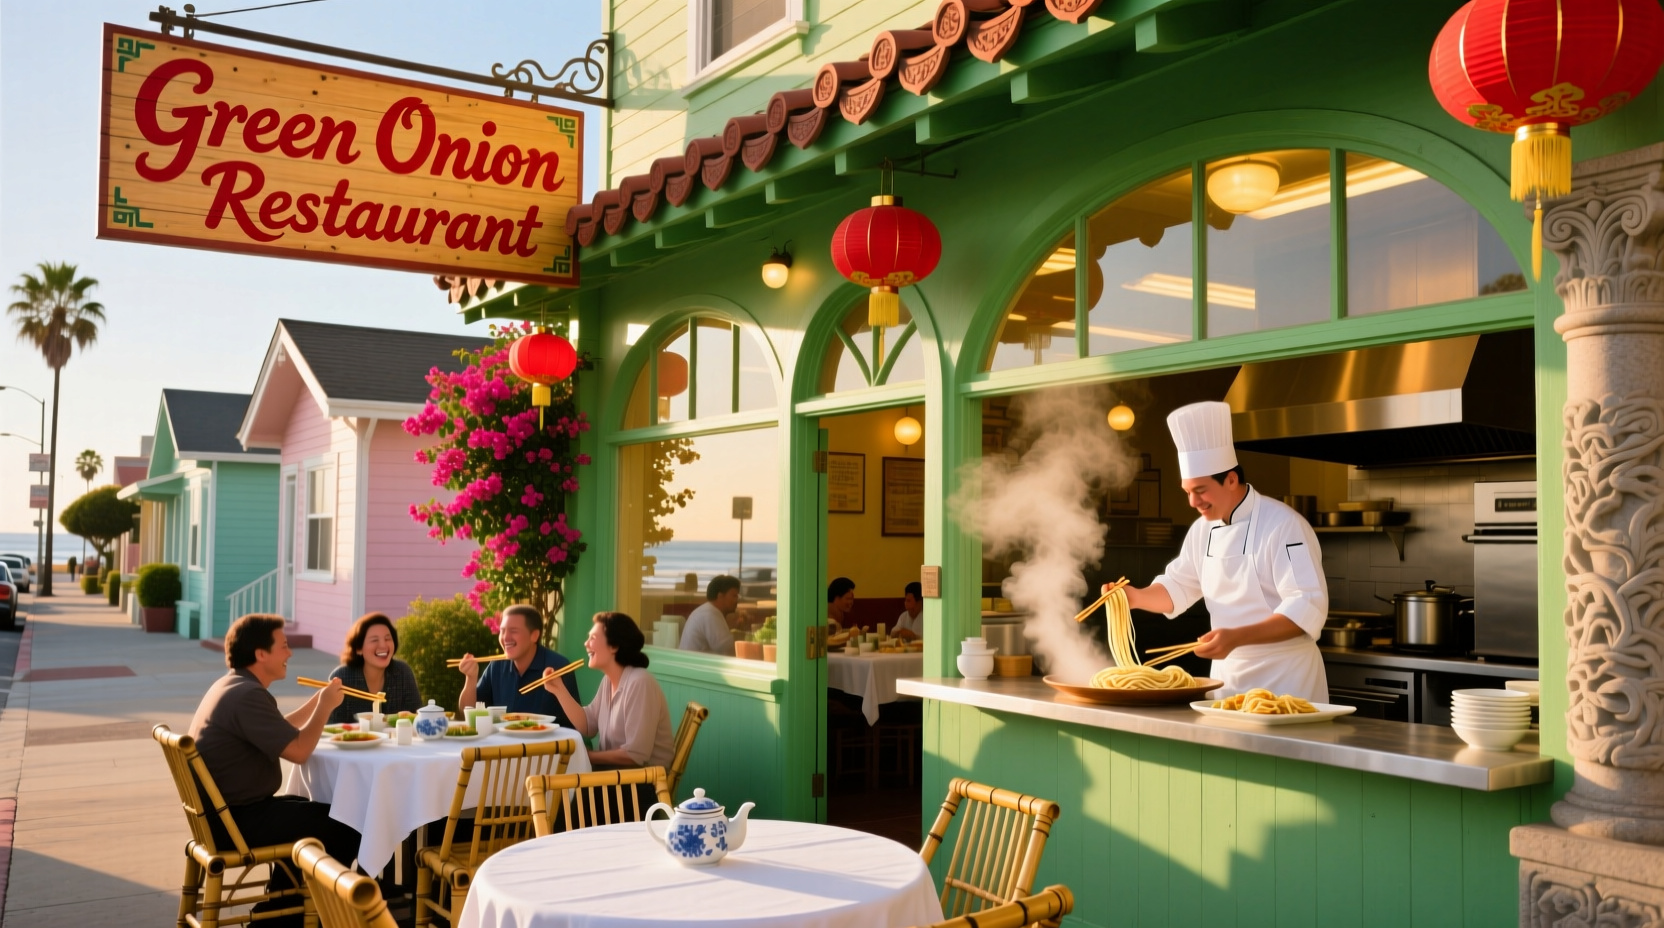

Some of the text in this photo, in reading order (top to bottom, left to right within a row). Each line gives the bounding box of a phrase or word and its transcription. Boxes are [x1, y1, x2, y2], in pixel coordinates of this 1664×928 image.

[135, 58, 564, 192] Green Onion
[201, 161, 543, 258] Restaurant
